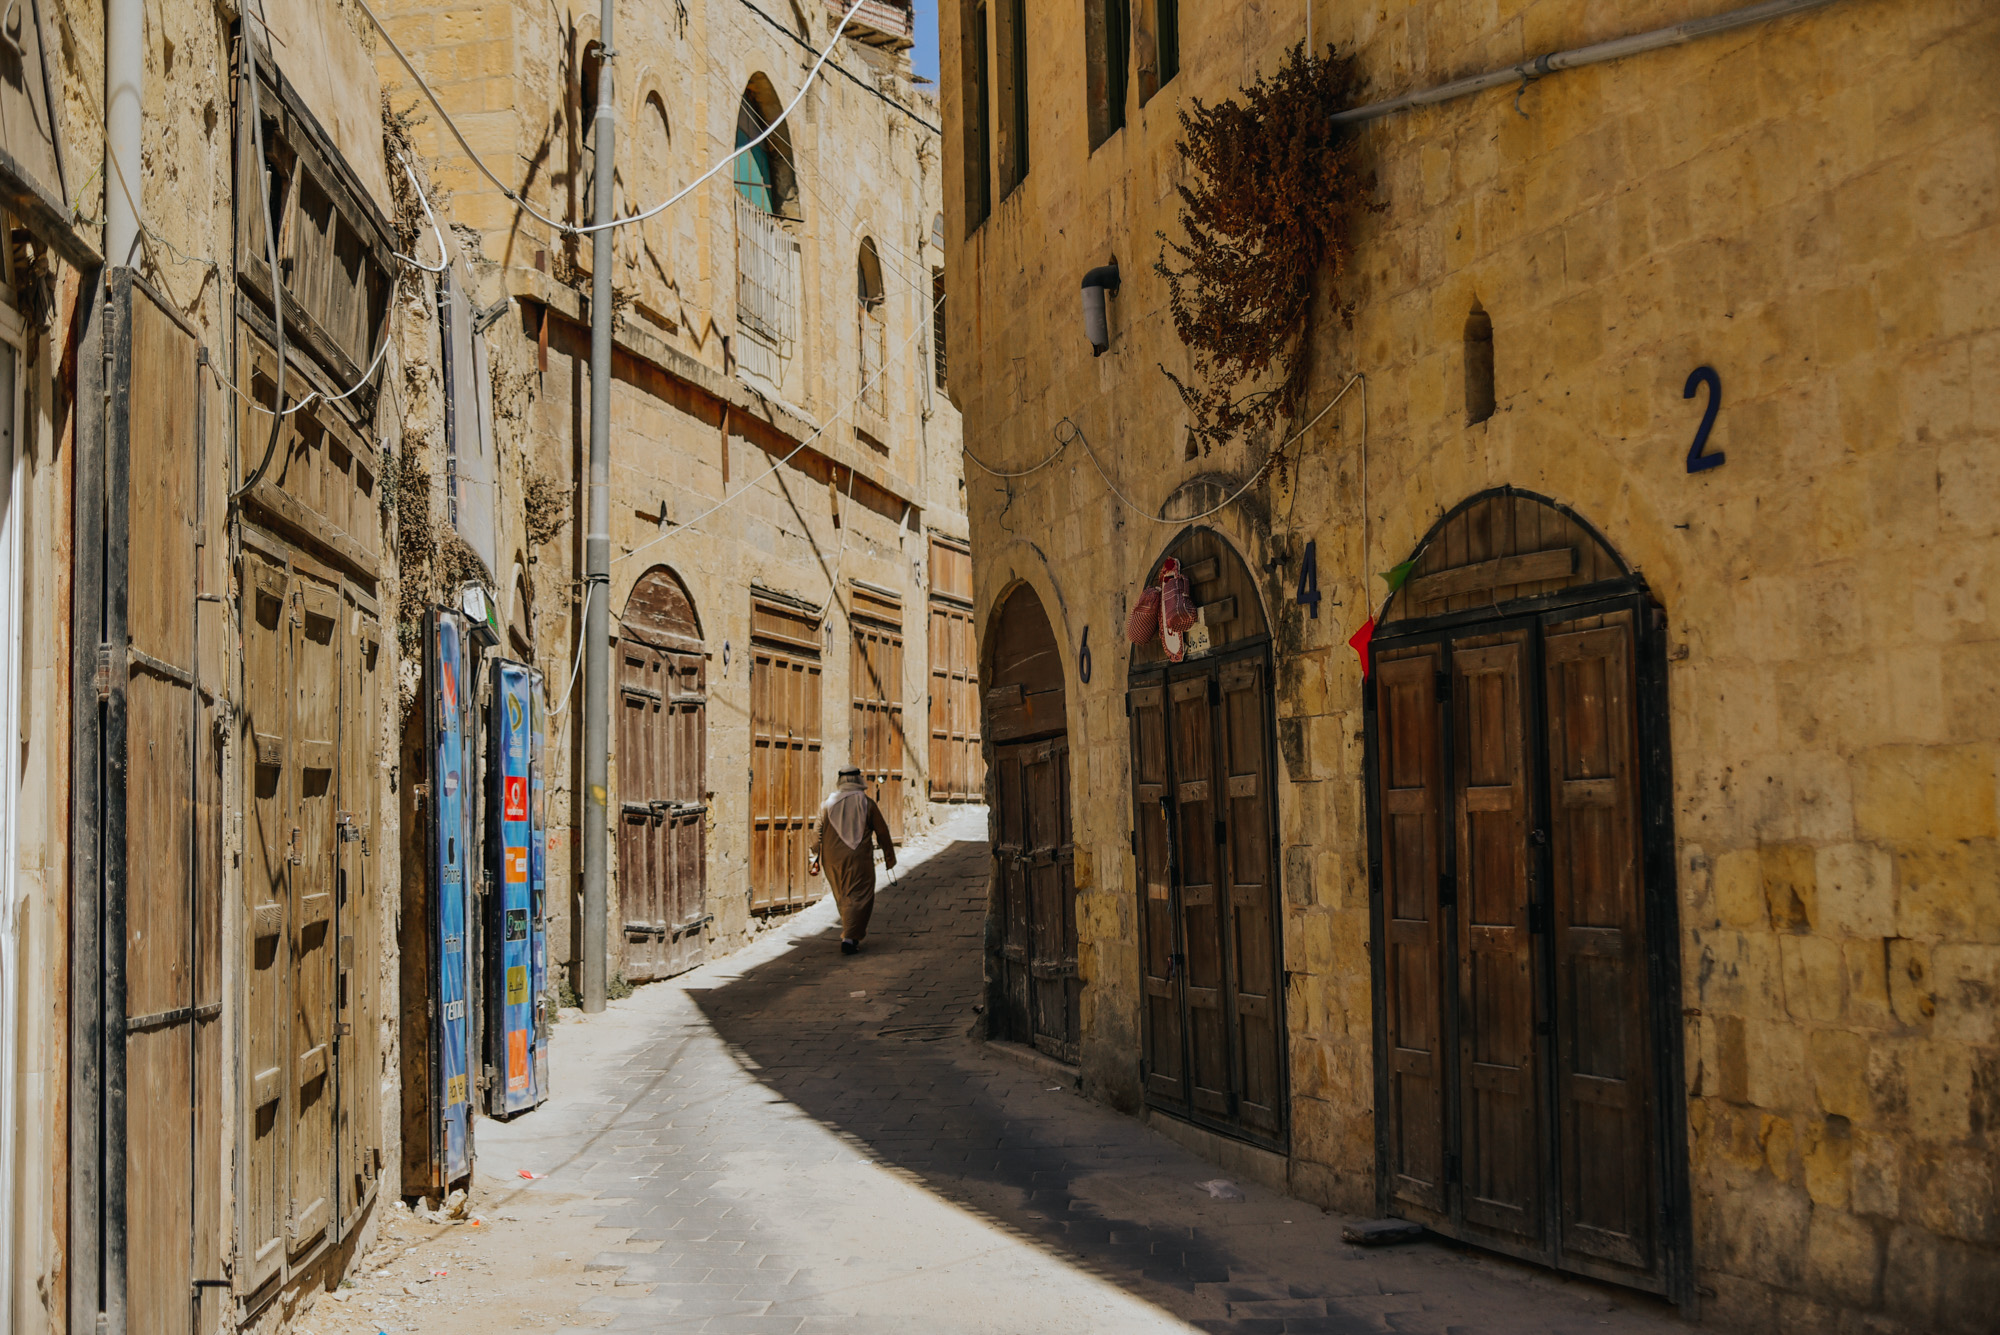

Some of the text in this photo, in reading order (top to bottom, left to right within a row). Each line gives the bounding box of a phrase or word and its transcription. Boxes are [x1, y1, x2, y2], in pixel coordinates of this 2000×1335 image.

[1683, 366, 1726, 474] 2
[1297, 539, 1321, 619] 4
[723, 639, 731, 679] 9
[1079, 625, 1092, 684] 6
